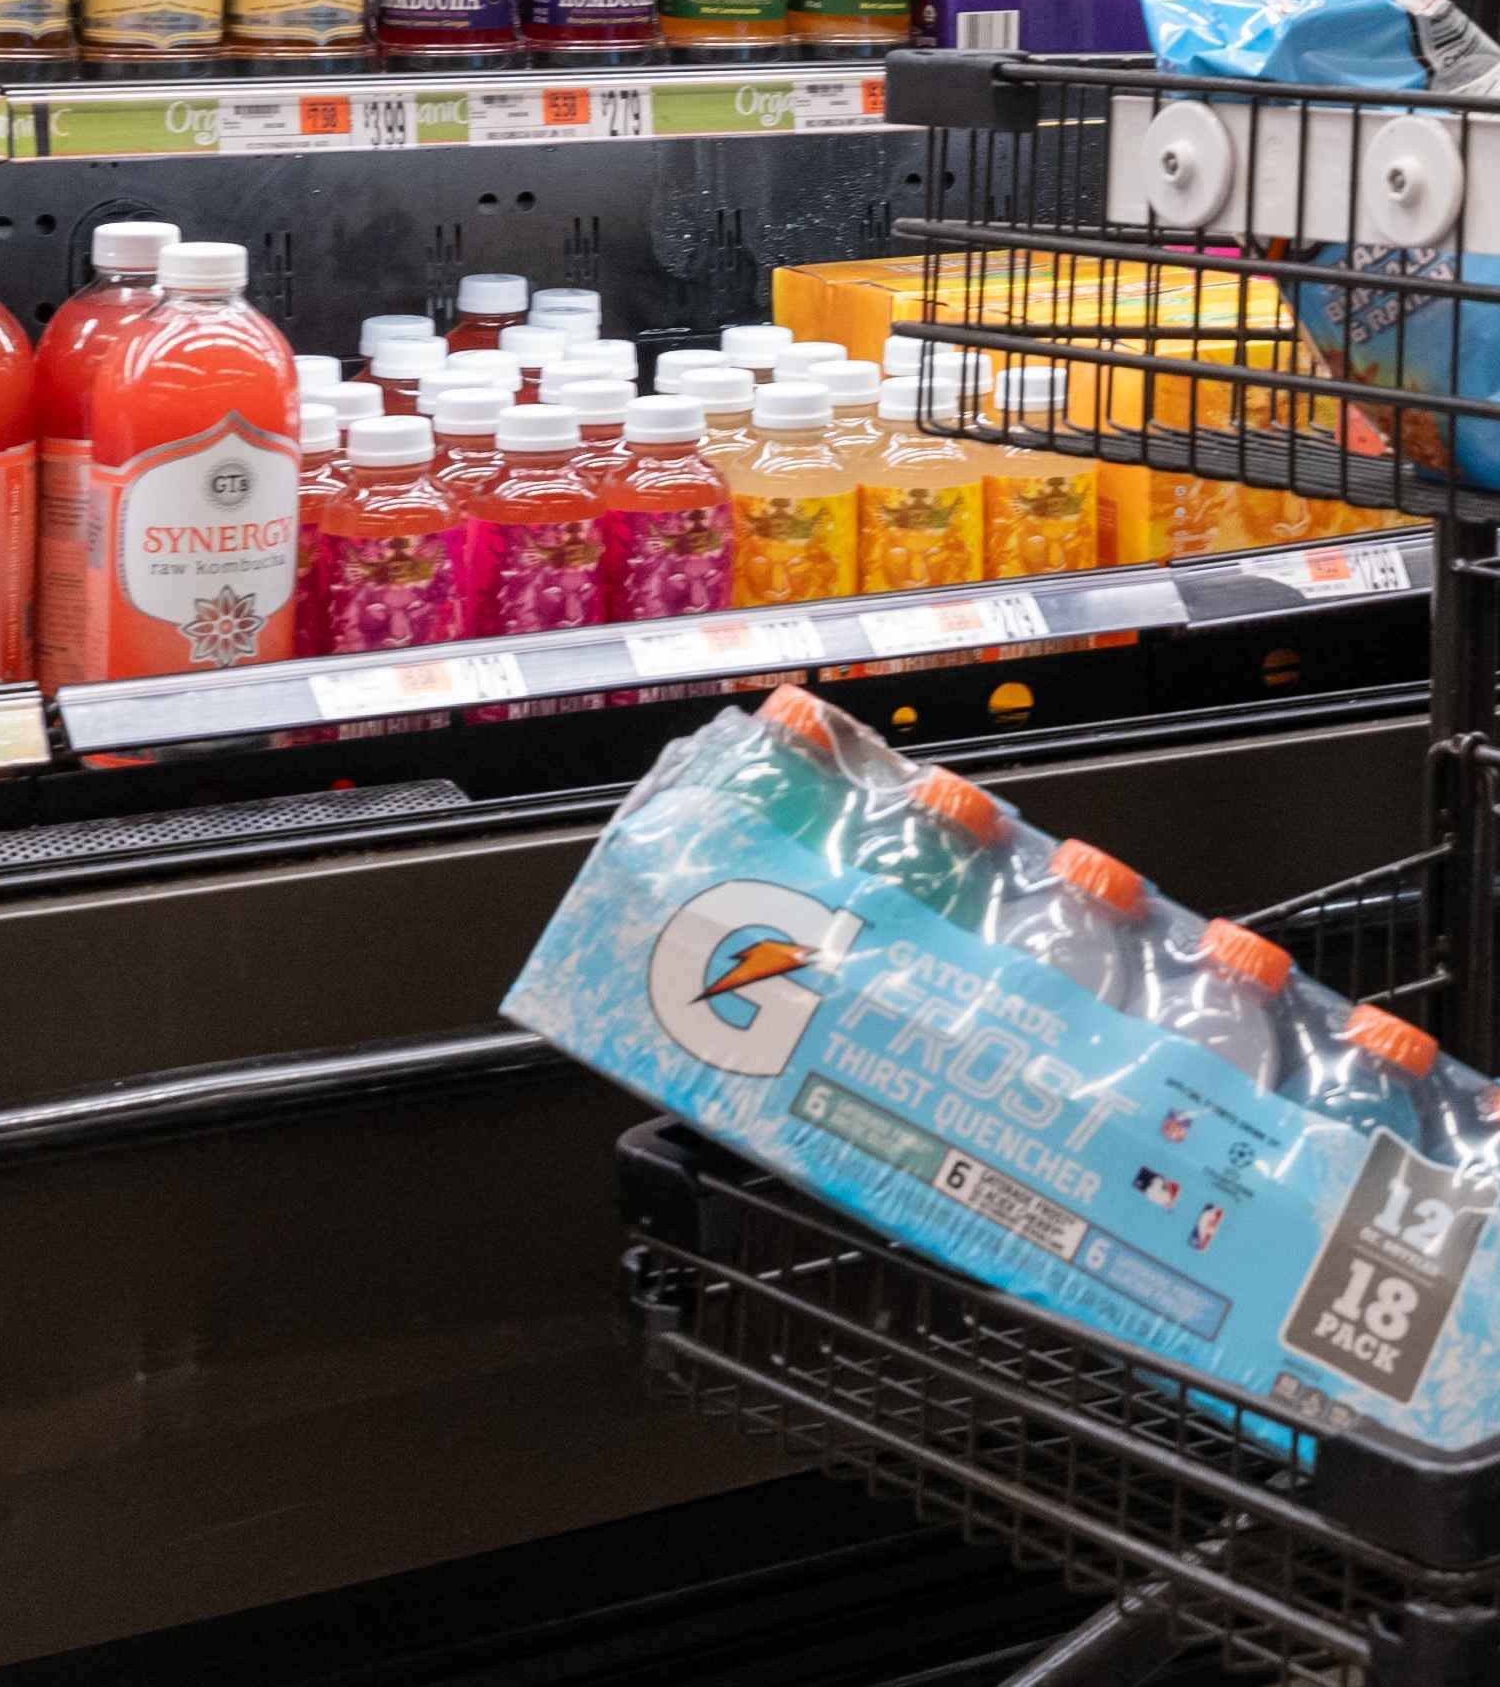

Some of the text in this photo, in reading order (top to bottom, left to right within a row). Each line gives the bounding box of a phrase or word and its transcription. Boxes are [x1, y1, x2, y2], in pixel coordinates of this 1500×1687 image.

[888, 941, 1069, 1047] GATORADE
[806, 1086, 828, 1115] 6
[840, 971, 1141, 1153] FROST
[822, 1034, 934, 1110] THIRST
[933, 1096, 1100, 1203] QUENCHER
[945, 1160, 970, 1189] 6
[1373, 1173, 1455, 1255] 12
[1084, 1239, 1103, 1270] 6
[1332, 1259, 1419, 1341] 18
[1312, 1314, 1401, 1374] PACK
